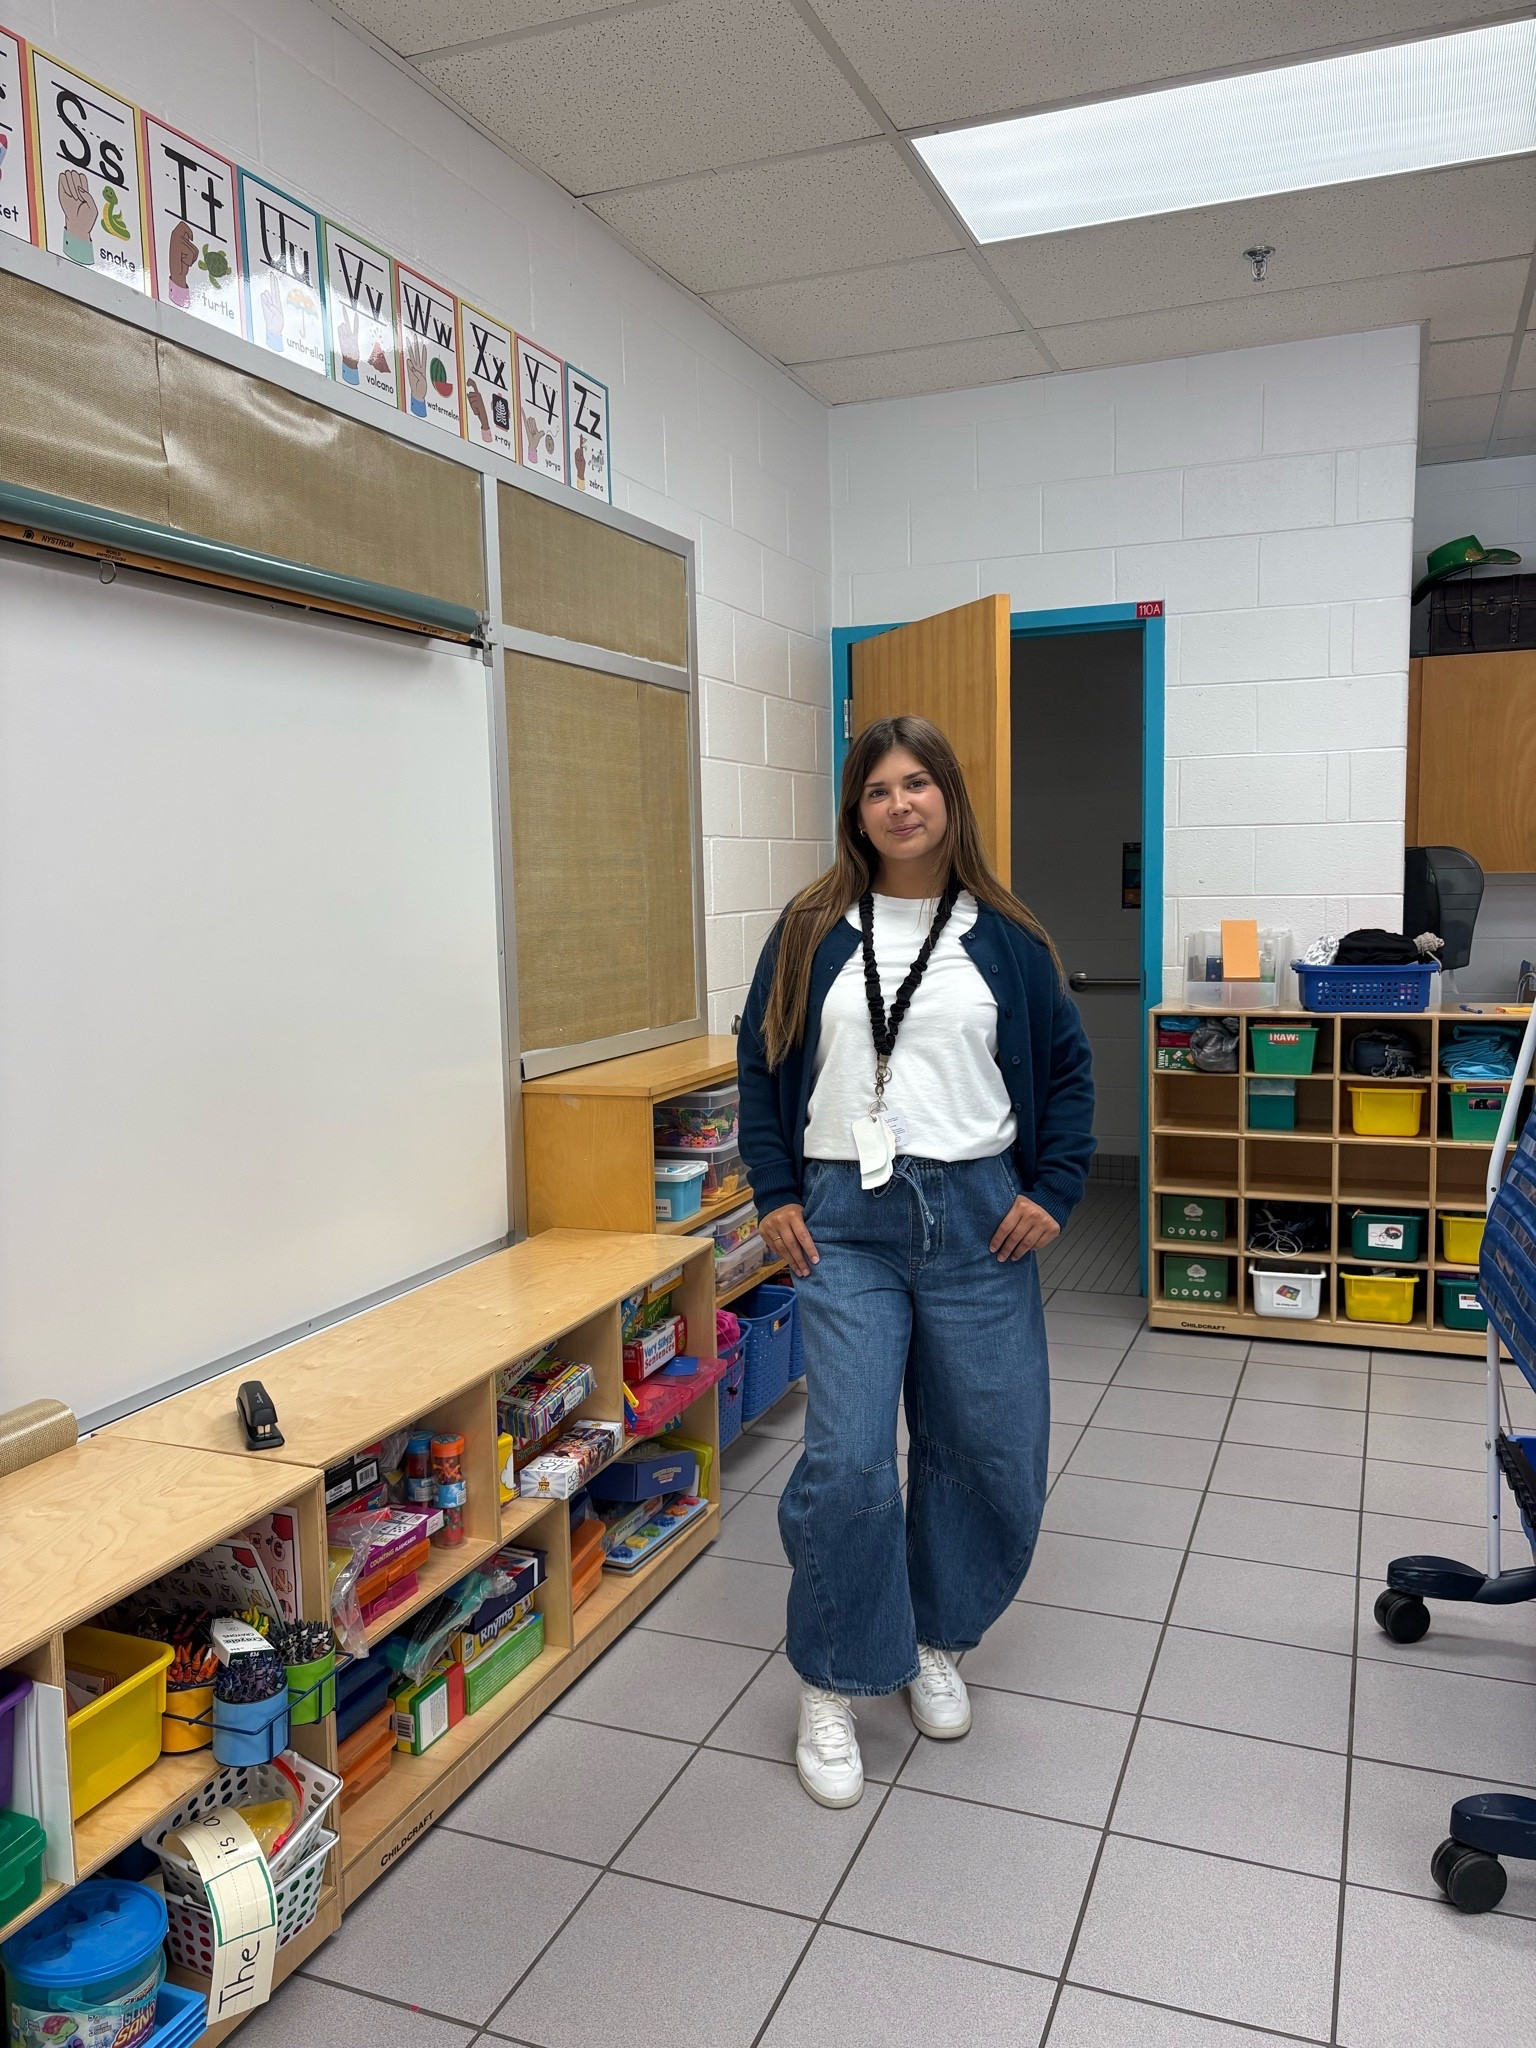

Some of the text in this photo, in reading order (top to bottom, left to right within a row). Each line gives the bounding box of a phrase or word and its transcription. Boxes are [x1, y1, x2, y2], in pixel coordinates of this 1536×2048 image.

[57, 90, 125, 186] Ss
[164, 147, 224, 236] Tt
[259, 202, 310, 287] Uu
[99, 246, 136, 273] snake
[338, 248, 383, 321] Vv
[201, 293, 235, 320] turtle
[403, 284, 453, 349] Ww
[286, 336, 325, 362] umbrella
[472, 324, 507, 390] Xx
[366, 373, 394, 394] volcano
[525, 356, 556, 425] Yy
[427, 400, 460, 422] watermelon
[573, 384, 602, 440] Zz
[494, 433, 511, 450] x-ray
[544, 457, 561, 472] yo-yo
[588, 479, 603, 492] zebra
[41, 534, 75, 549] NYSTROM
[1138, 604, 1161, 616] 110A
[644, 1341, 657, 1358] Very
[657, 1334, 669, 1350] Silly
[644, 1342, 675, 1370] Sentences
[369, 1548, 395, 1569] COUNTING
[217, 1836, 239, 1859] is
[380, 1809, 435, 1867] CHILDCRAFT
[208, 1940, 261, 2014] The
[113, 2000, 156, 2046] SAND
